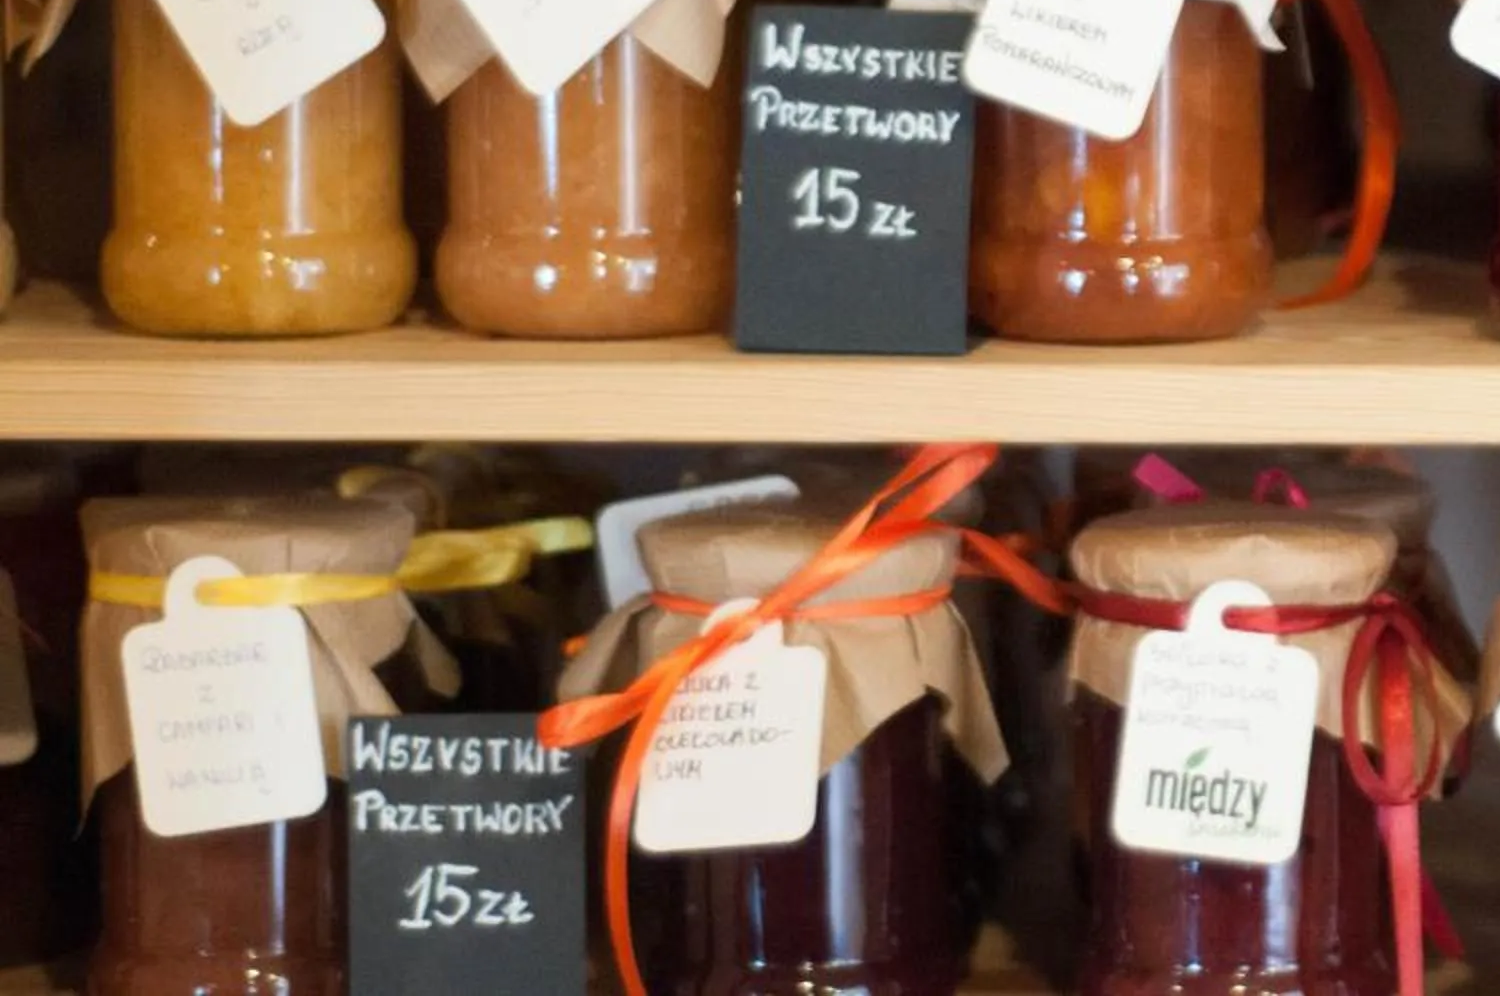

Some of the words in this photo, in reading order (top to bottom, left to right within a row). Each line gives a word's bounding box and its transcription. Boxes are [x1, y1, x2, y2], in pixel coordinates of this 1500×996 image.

[763, 22, 964, 83] WSZYSTKIE
[749, 85, 960, 145] PRZETWORY
[793, 167, 861, 231] 15
[353, 721, 572, 776] WSZYSTKIE
[353, 789, 574, 834] PRZETWORY
[1145, 768, 1268, 829] między
[398, 863, 480, 929] 15
